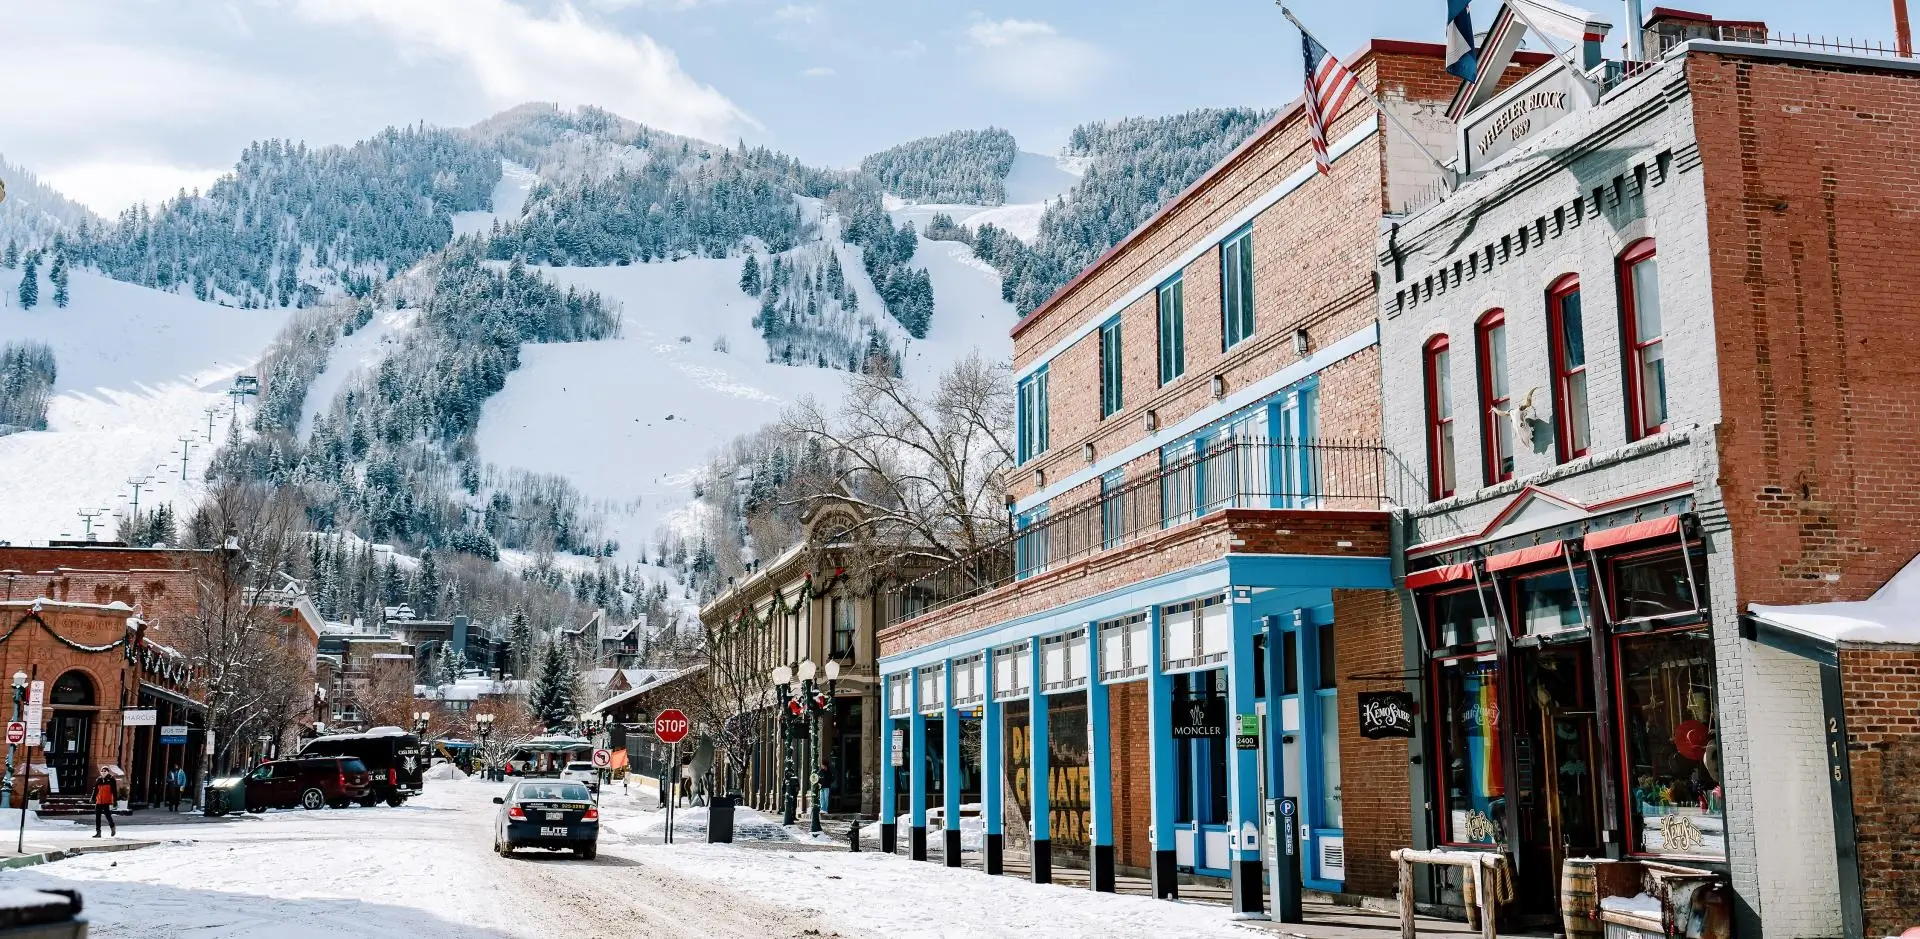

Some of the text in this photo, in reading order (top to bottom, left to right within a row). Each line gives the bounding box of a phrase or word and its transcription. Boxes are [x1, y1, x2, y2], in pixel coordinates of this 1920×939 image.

[1476, 91, 1566, 155] WHEELER BLOCK
[124, 712, 156, 721] MARCUS
[657, 719, 687, 733] STOP
[1174, 726, 1221, 735] MONCLER
[540, 826, 568, 834] ELITE
